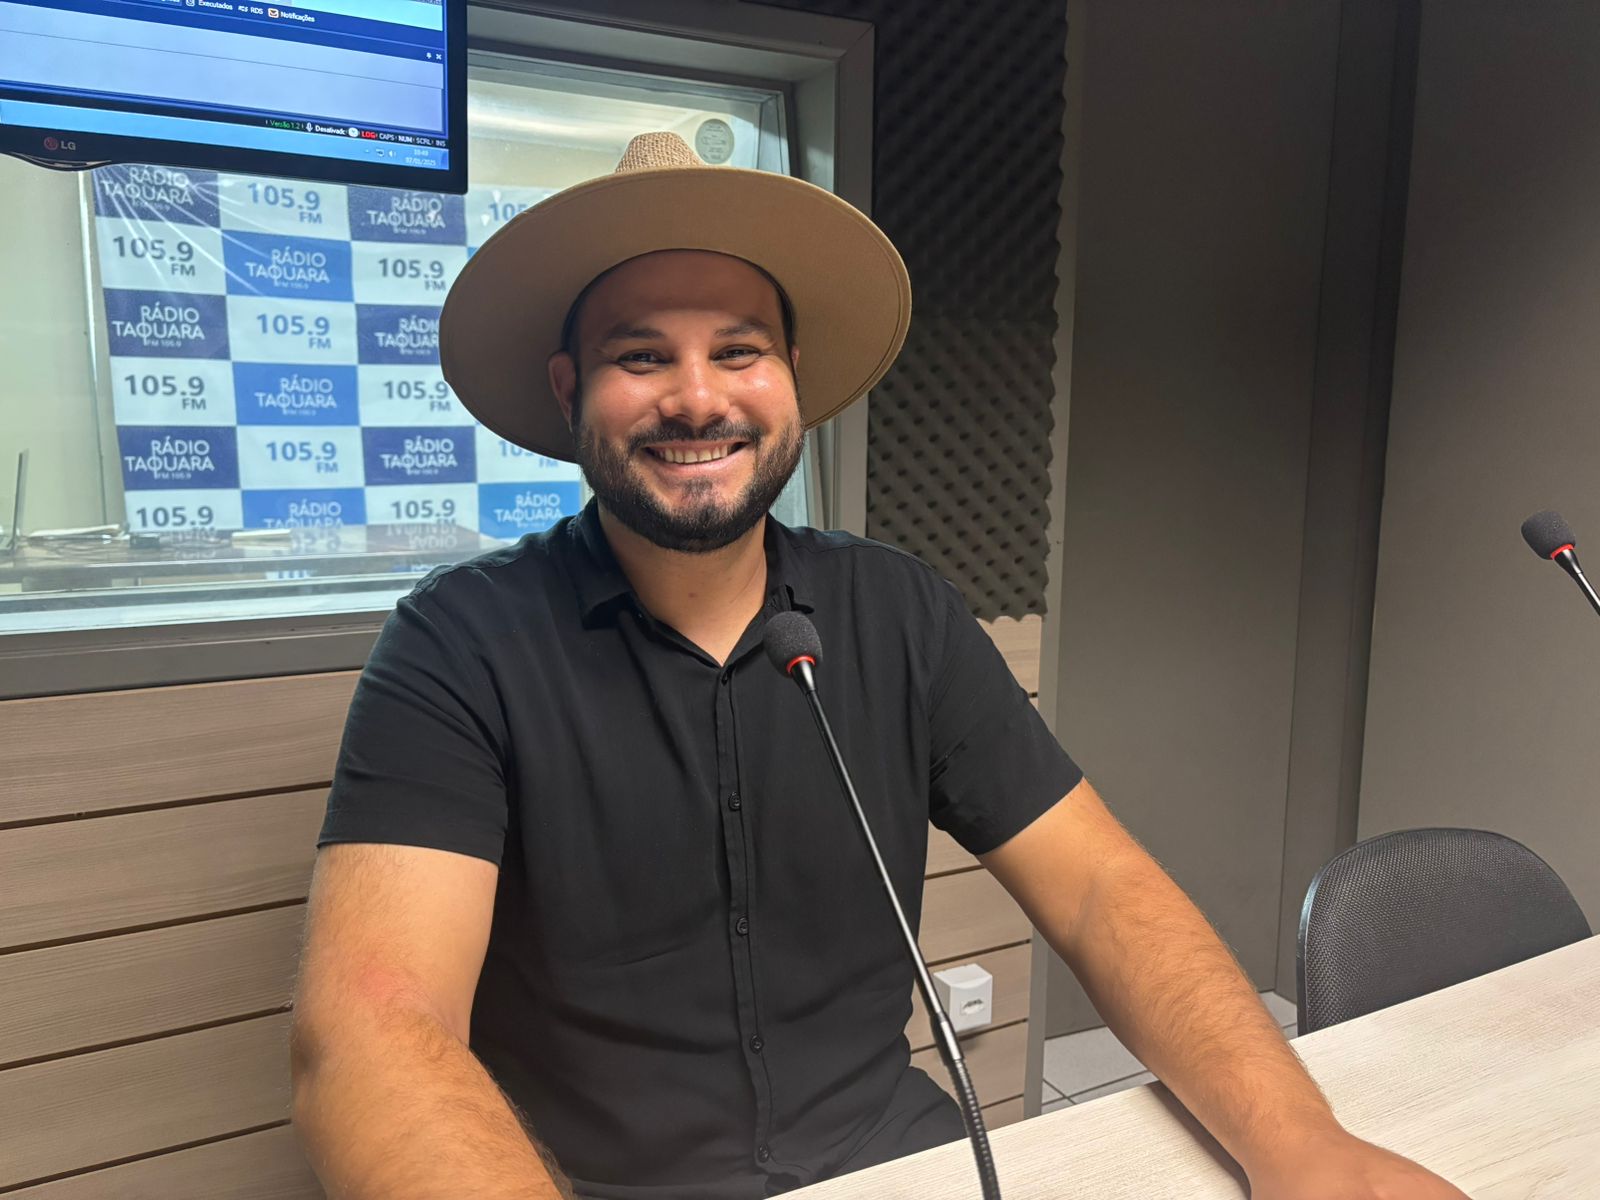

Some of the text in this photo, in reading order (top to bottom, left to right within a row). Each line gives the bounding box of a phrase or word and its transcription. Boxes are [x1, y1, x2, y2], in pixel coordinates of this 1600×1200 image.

[280, 11, 316, 23] Notificações
[361, 130, 376, 139] LOG
[379, 132, 395, 141] CAPS
[398, 135, 413, 143] NUM
[416, 137, 431, 145] SCRL
[60, 140, 76, 151] LG
[100, 181, 194, 205] TAQUARA
[247, 183, 320, 210] 105.9
[391, 192, 441, 212] RÁDIO
[299, 212, 322, 224] FM
[366, 210, 445, 229] TAQUARA
[113, 235, 193, 262] 105.9
[271, 246, 326, 268] RÁDIO
[171, 264, 195, 276] FM
[245, 262, 330, 286] TAQUARA
[378, 258, 444, 278] 105.9
[424, 281, 446, 291] FM
[141, 301, 199, 323] RÁDIO
[112, 320, 205, 342] TAQUARA
[257, 314, 329, 336] 105.9
[308, 337, 331, 349] FM
[124, 375, 204, 396] 105.9
[279, 374, 332, 393] RÁDIO
[383, 381, 449, 399] 105.9
[182, 399, 207, 410] FM
[255, 393, 337, 411] TAQUARA
[430, 402, 451, 411] FM
[151, 436, 209, 455] RÁDIO
[267, 442, 337, 461] 105.9
[404, 436, 454, 453] RÁDIO
[124, 456, 214, 474] TAQUARA
[316, 463, 338, 473] FM
[380, 454, 458, 470] TAQUARA
[516, 491, 560, 506] RÁDIO
[137, 506, 214, 527] 105.9
[288, 499, 342, 517] RÁDIO
[392, 500, 455, 519] 105.9
[493, 508, 564, 523] TAQUARA
